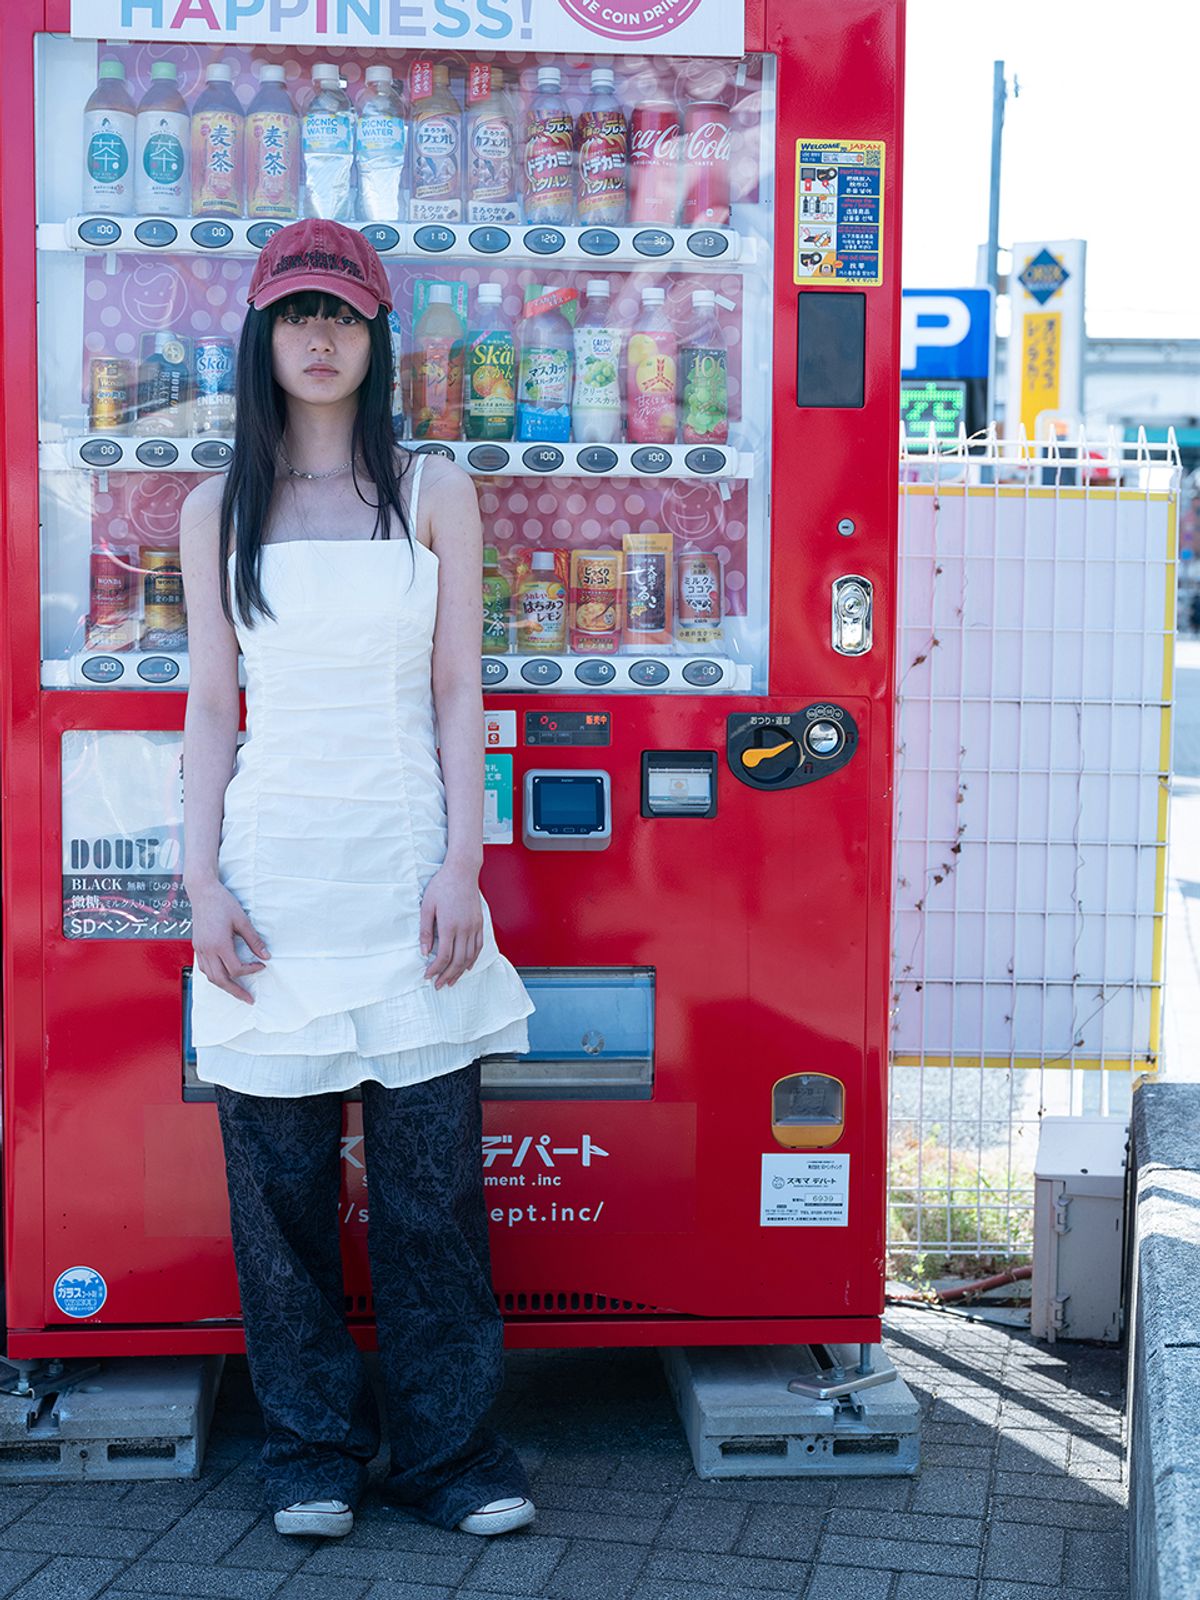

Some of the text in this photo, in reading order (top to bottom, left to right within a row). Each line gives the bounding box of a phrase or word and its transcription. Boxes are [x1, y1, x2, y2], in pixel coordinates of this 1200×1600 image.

[601, 8, 641, 25] COIN
[306, 126, 338, 136] WATER
[361, 128, 394, 137] WATER
[208, 123, 235, 174] 麦茶
[263, 125, 288, 177] 麦茶
[848, 143, 881, 152] JAPAN
[901, 295, 972, 371] P
[687, 585, 713, 594] ココア
[522, 600, 564, 614] はちみつ
[537, 611, 562, 623] レモン
[585, 714, 608, 726] 販売中
[749, 715, 792, 726] おつり・返却
[71, 878, 122, 891] BLACK
[482, 1134, 609, 1168] デパート
[484, 1173, 562, 1187] ment .inc
[787, 1177, 837, 1185] スキマ デパート
[490, 1200, 604, 1228] ept.inc/
